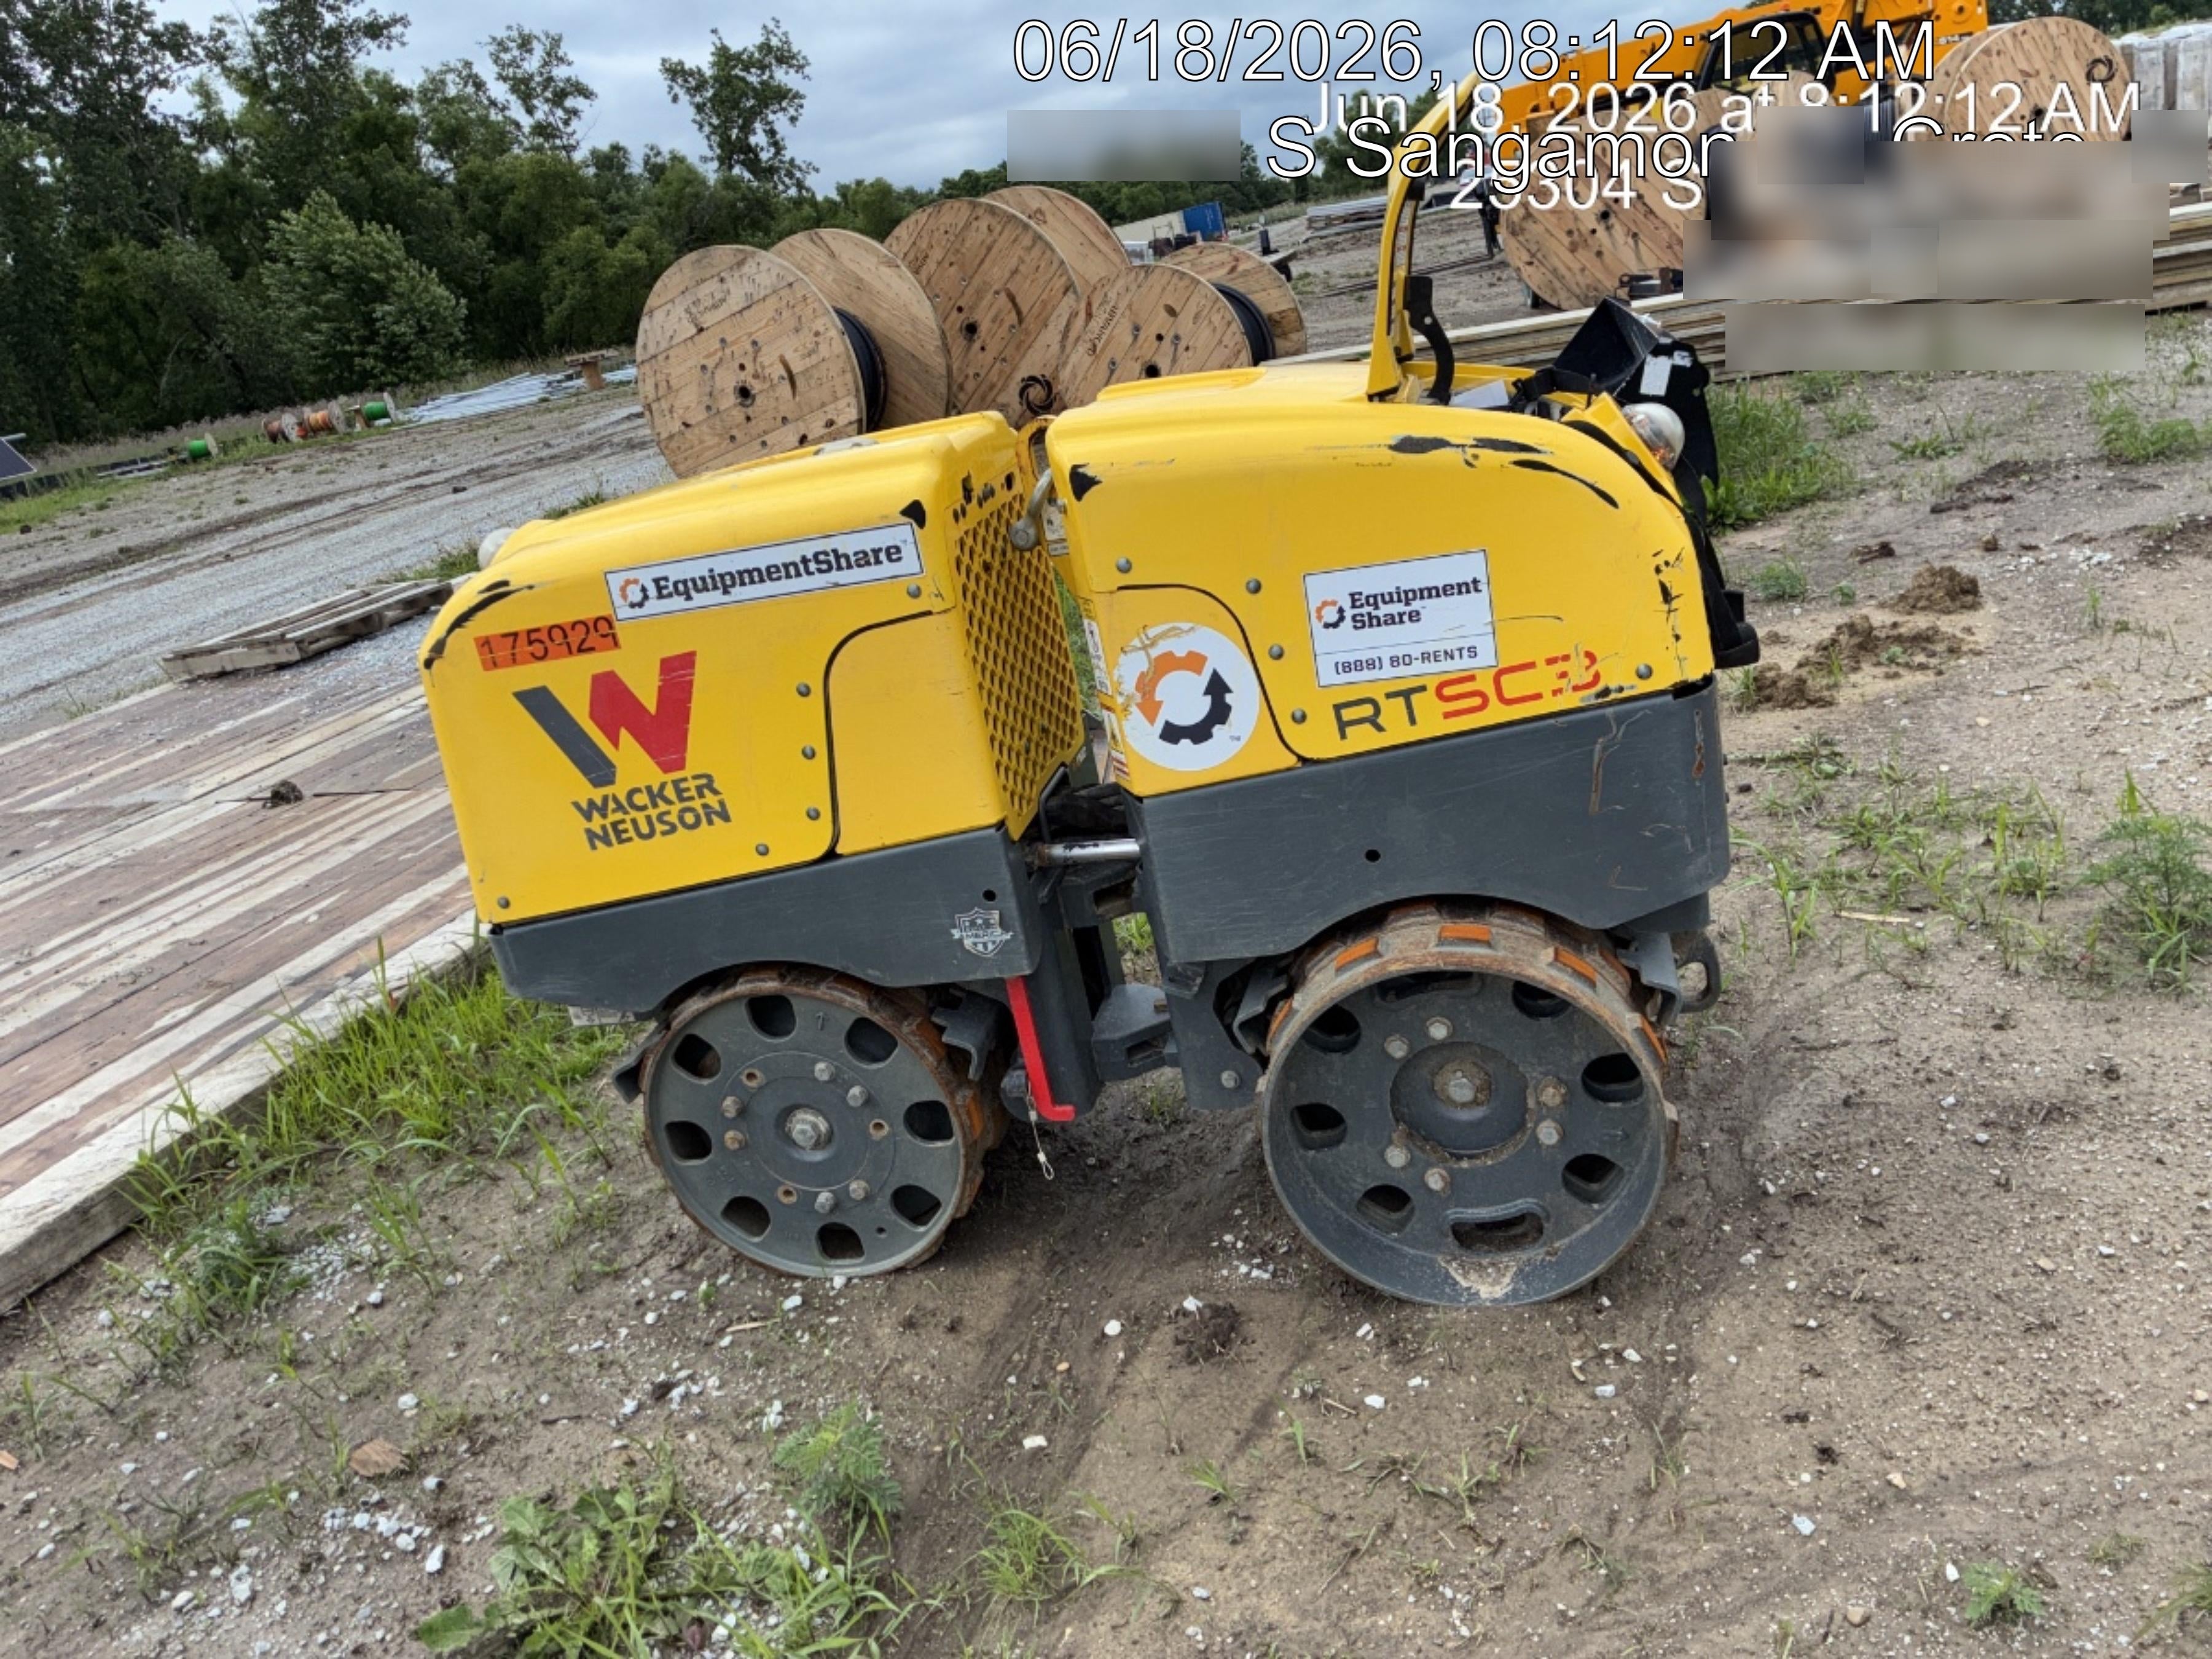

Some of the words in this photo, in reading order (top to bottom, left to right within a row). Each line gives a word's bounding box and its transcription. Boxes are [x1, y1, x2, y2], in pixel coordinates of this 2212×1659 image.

[652, 543, 903, 602] EquipmentShare
[1348, 576, 1483, 610] Equipment
[480, 615, 619, 669] 175929
[1351, 609, 1422, 630] Share
[1334, 656, 1383, 675] (888)
[1389, 645, 1478, 668] 80-RENTS
[570, 772, 723, 823] WACKER
[584, 798, 732, 851] NEUSON
